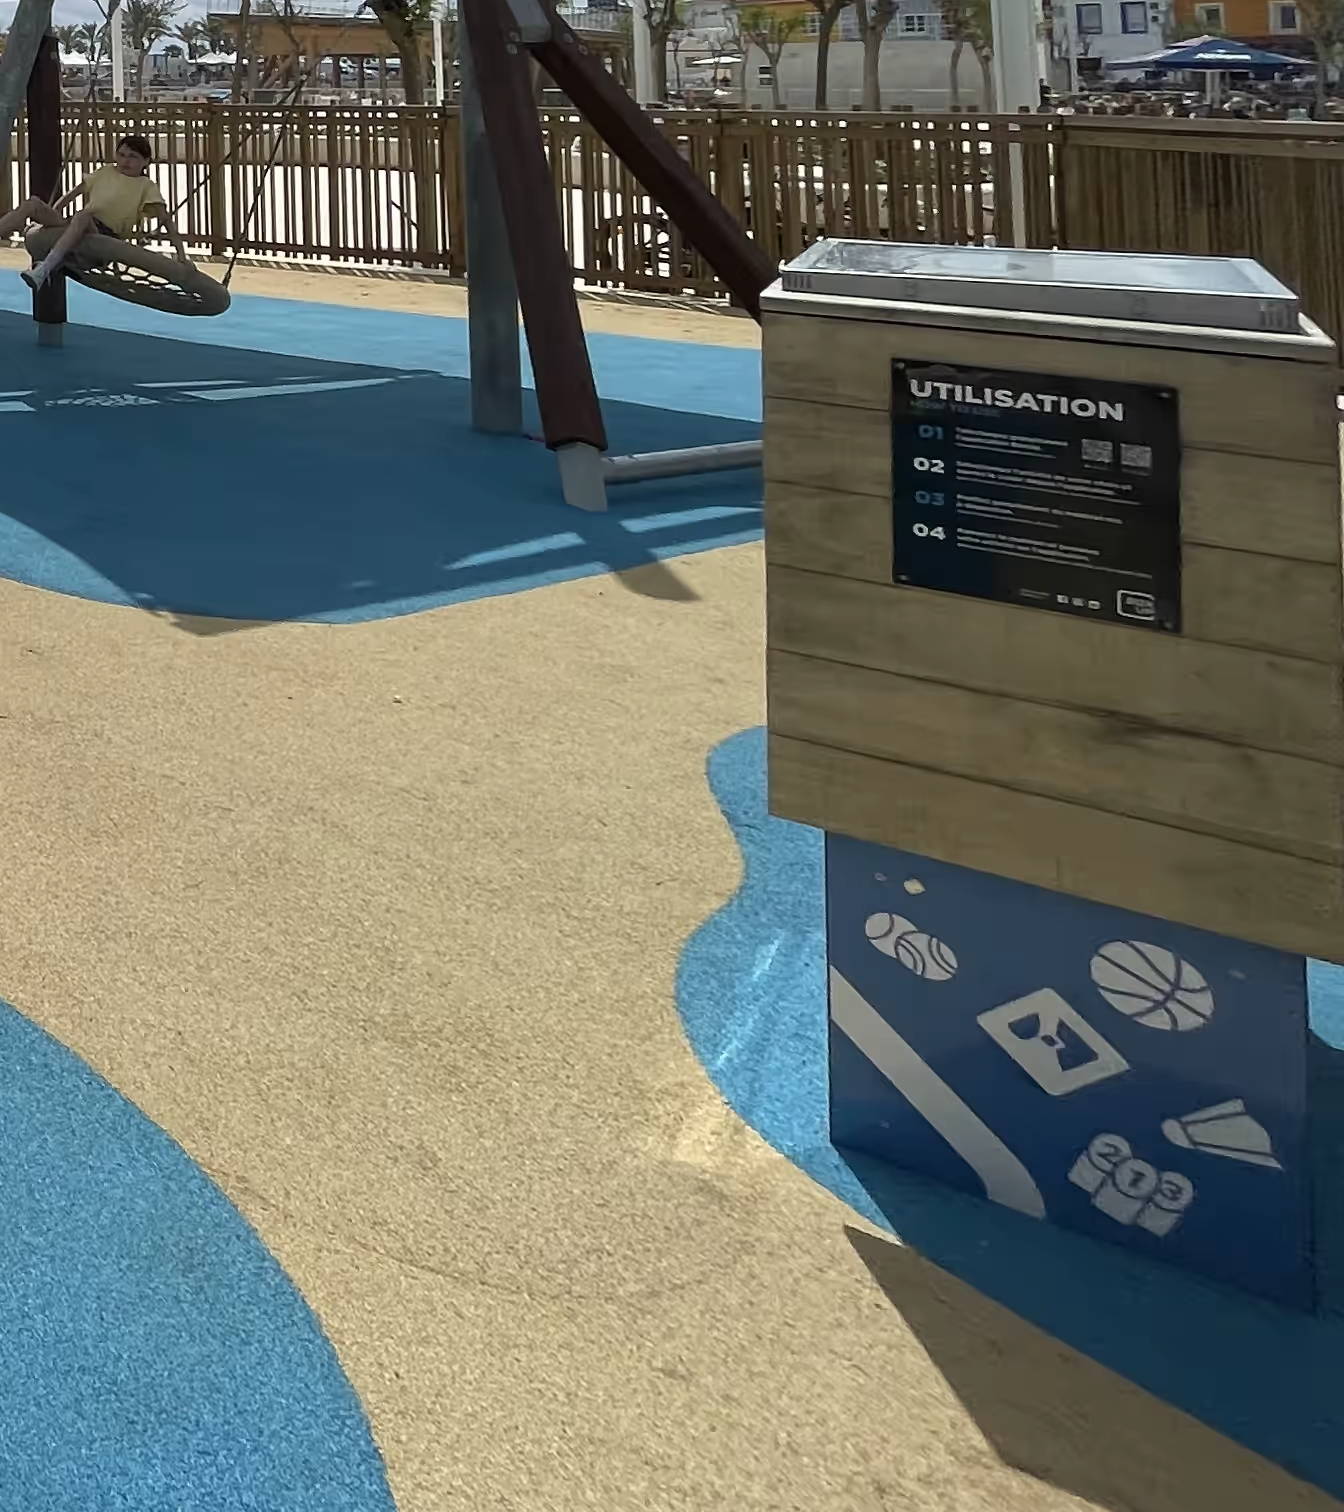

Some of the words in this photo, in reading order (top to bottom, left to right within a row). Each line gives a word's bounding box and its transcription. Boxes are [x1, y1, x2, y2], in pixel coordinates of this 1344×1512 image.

[910, 379, 1124, 421] UTILISATION
[918, 424, 944, 440] 01
[912, 456, 945, 474] 02
[914, 490, 945, 506] 03
[912, 522, 946, 541] 04
